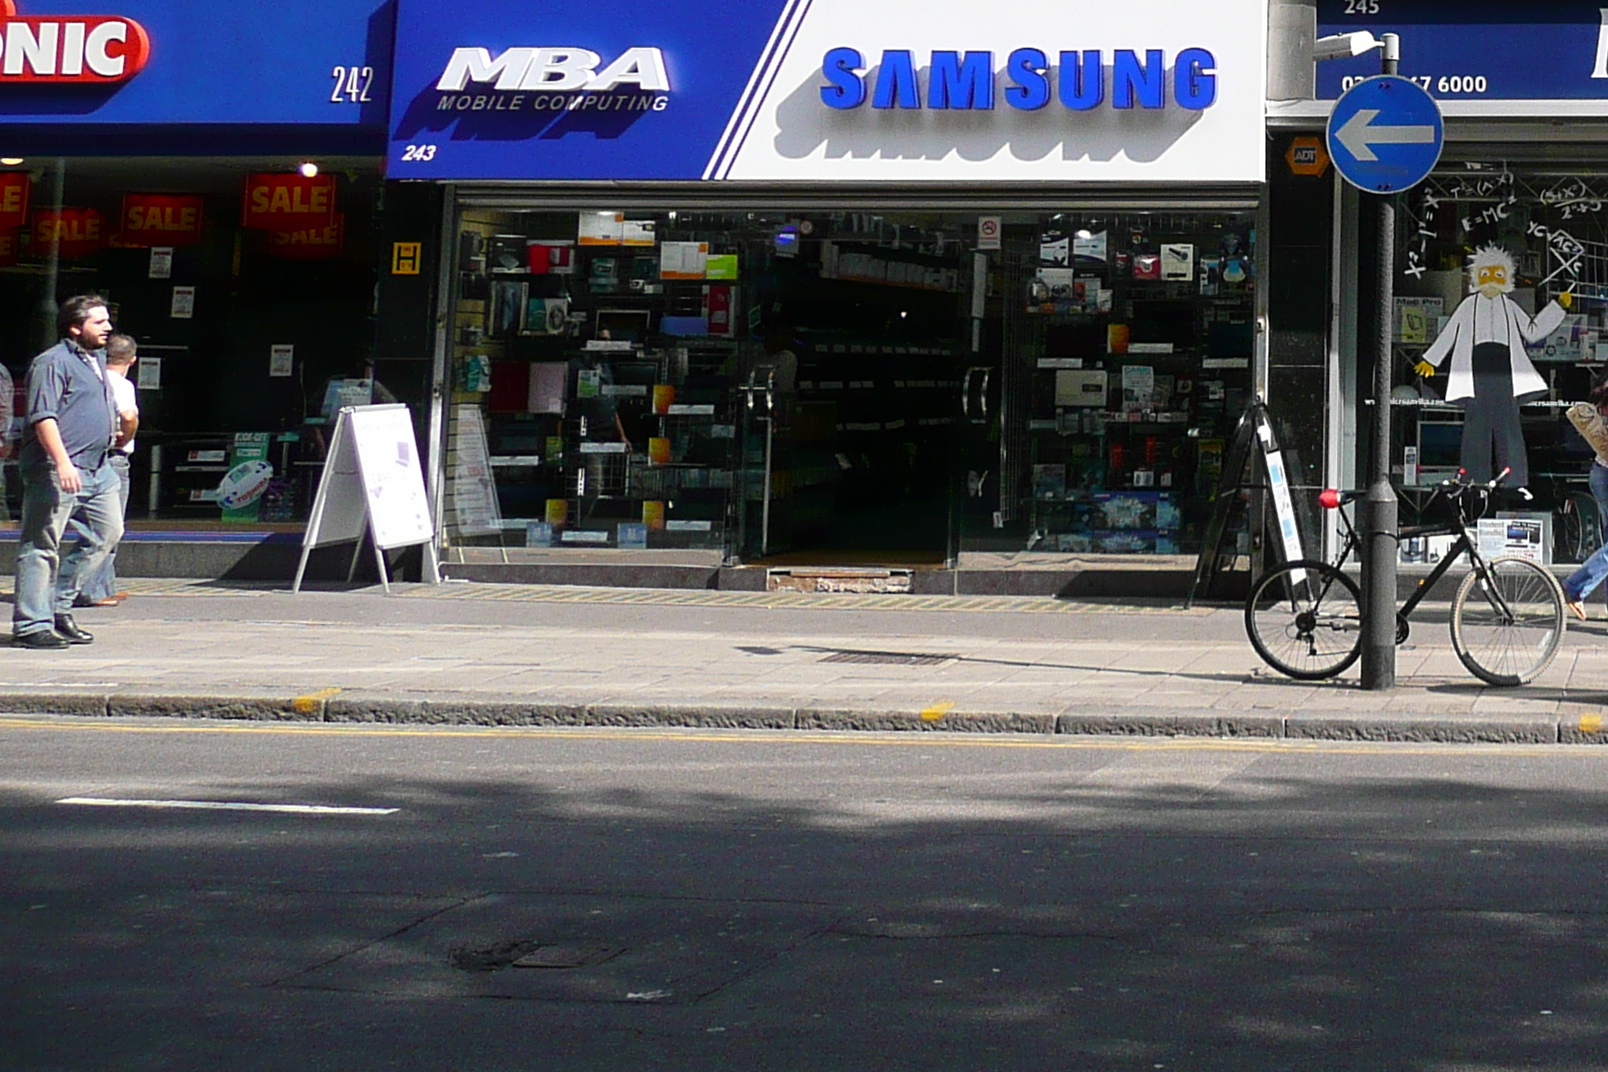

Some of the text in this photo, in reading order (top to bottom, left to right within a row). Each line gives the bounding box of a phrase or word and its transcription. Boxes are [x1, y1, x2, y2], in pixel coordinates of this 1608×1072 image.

[0, 21, 127, 77] NIC
[435, 46, 672, 92] MBA
[819, 46, 1219, 111] SAMSUNG
[330, 66, 374, 103] 242
[1437, 76, 1487, 93] 6000
[436, 95, 668, 111] MOBILE COMPUTING
[401, 144, 437, 162] 243
[1294, 149, 1316, 162] ADT
[251, 185, 329, 213] SALE
[37, 217, 101, 243] SALE
[128, 205, 197, 230] SALE
[1396, 298, 1442, 307] Mac Pro
